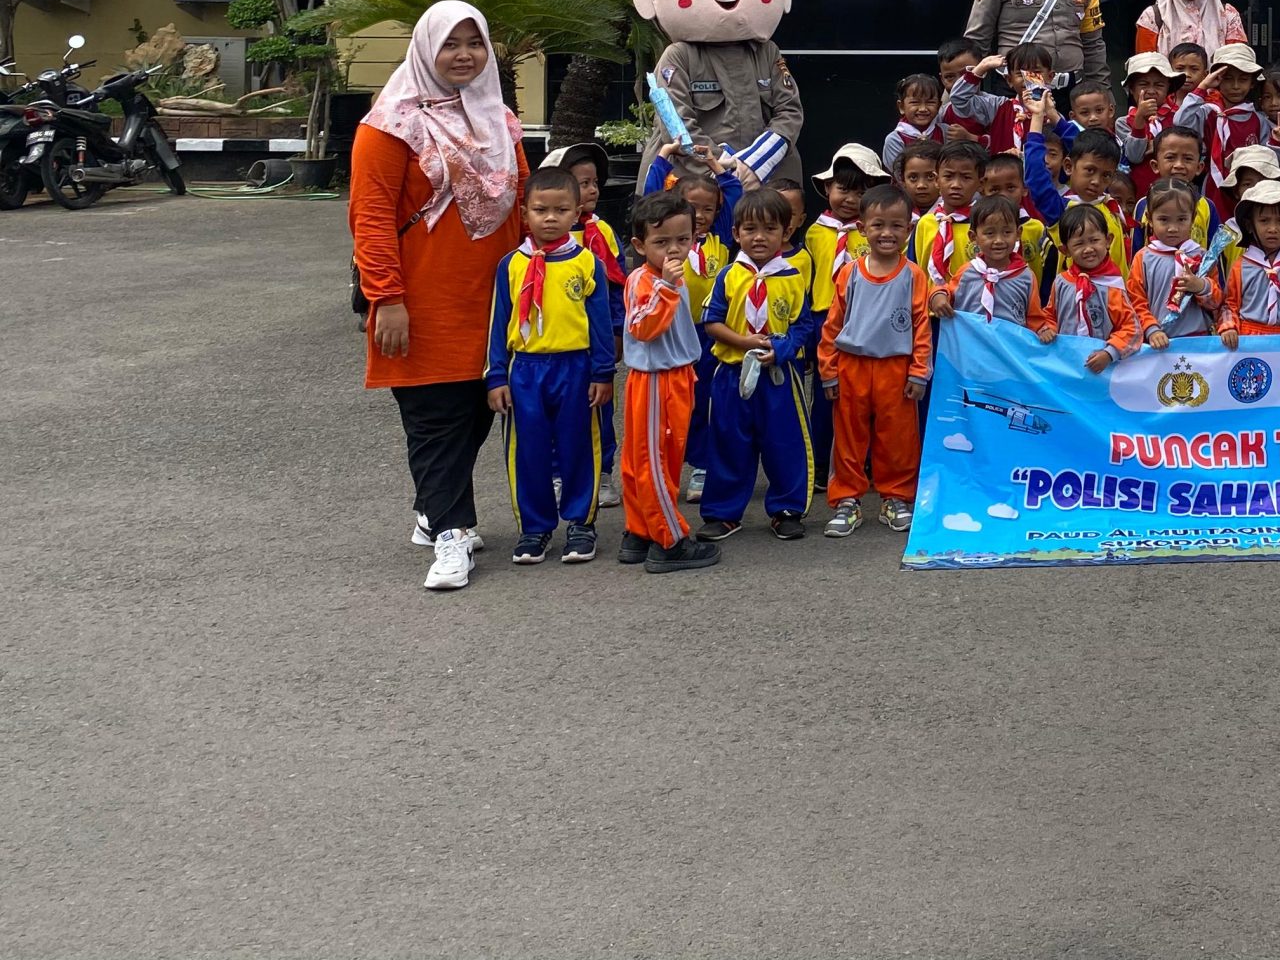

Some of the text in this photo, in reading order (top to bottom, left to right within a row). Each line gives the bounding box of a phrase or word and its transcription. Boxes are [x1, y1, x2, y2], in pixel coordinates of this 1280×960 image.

[1110, 431, 1266, 468] PUNCAK
[1027, 530, 1101, 540] PAUD
[1108, 528, 1142, 538] AL
[1099, 538, 1240, 548] SUKODADI
